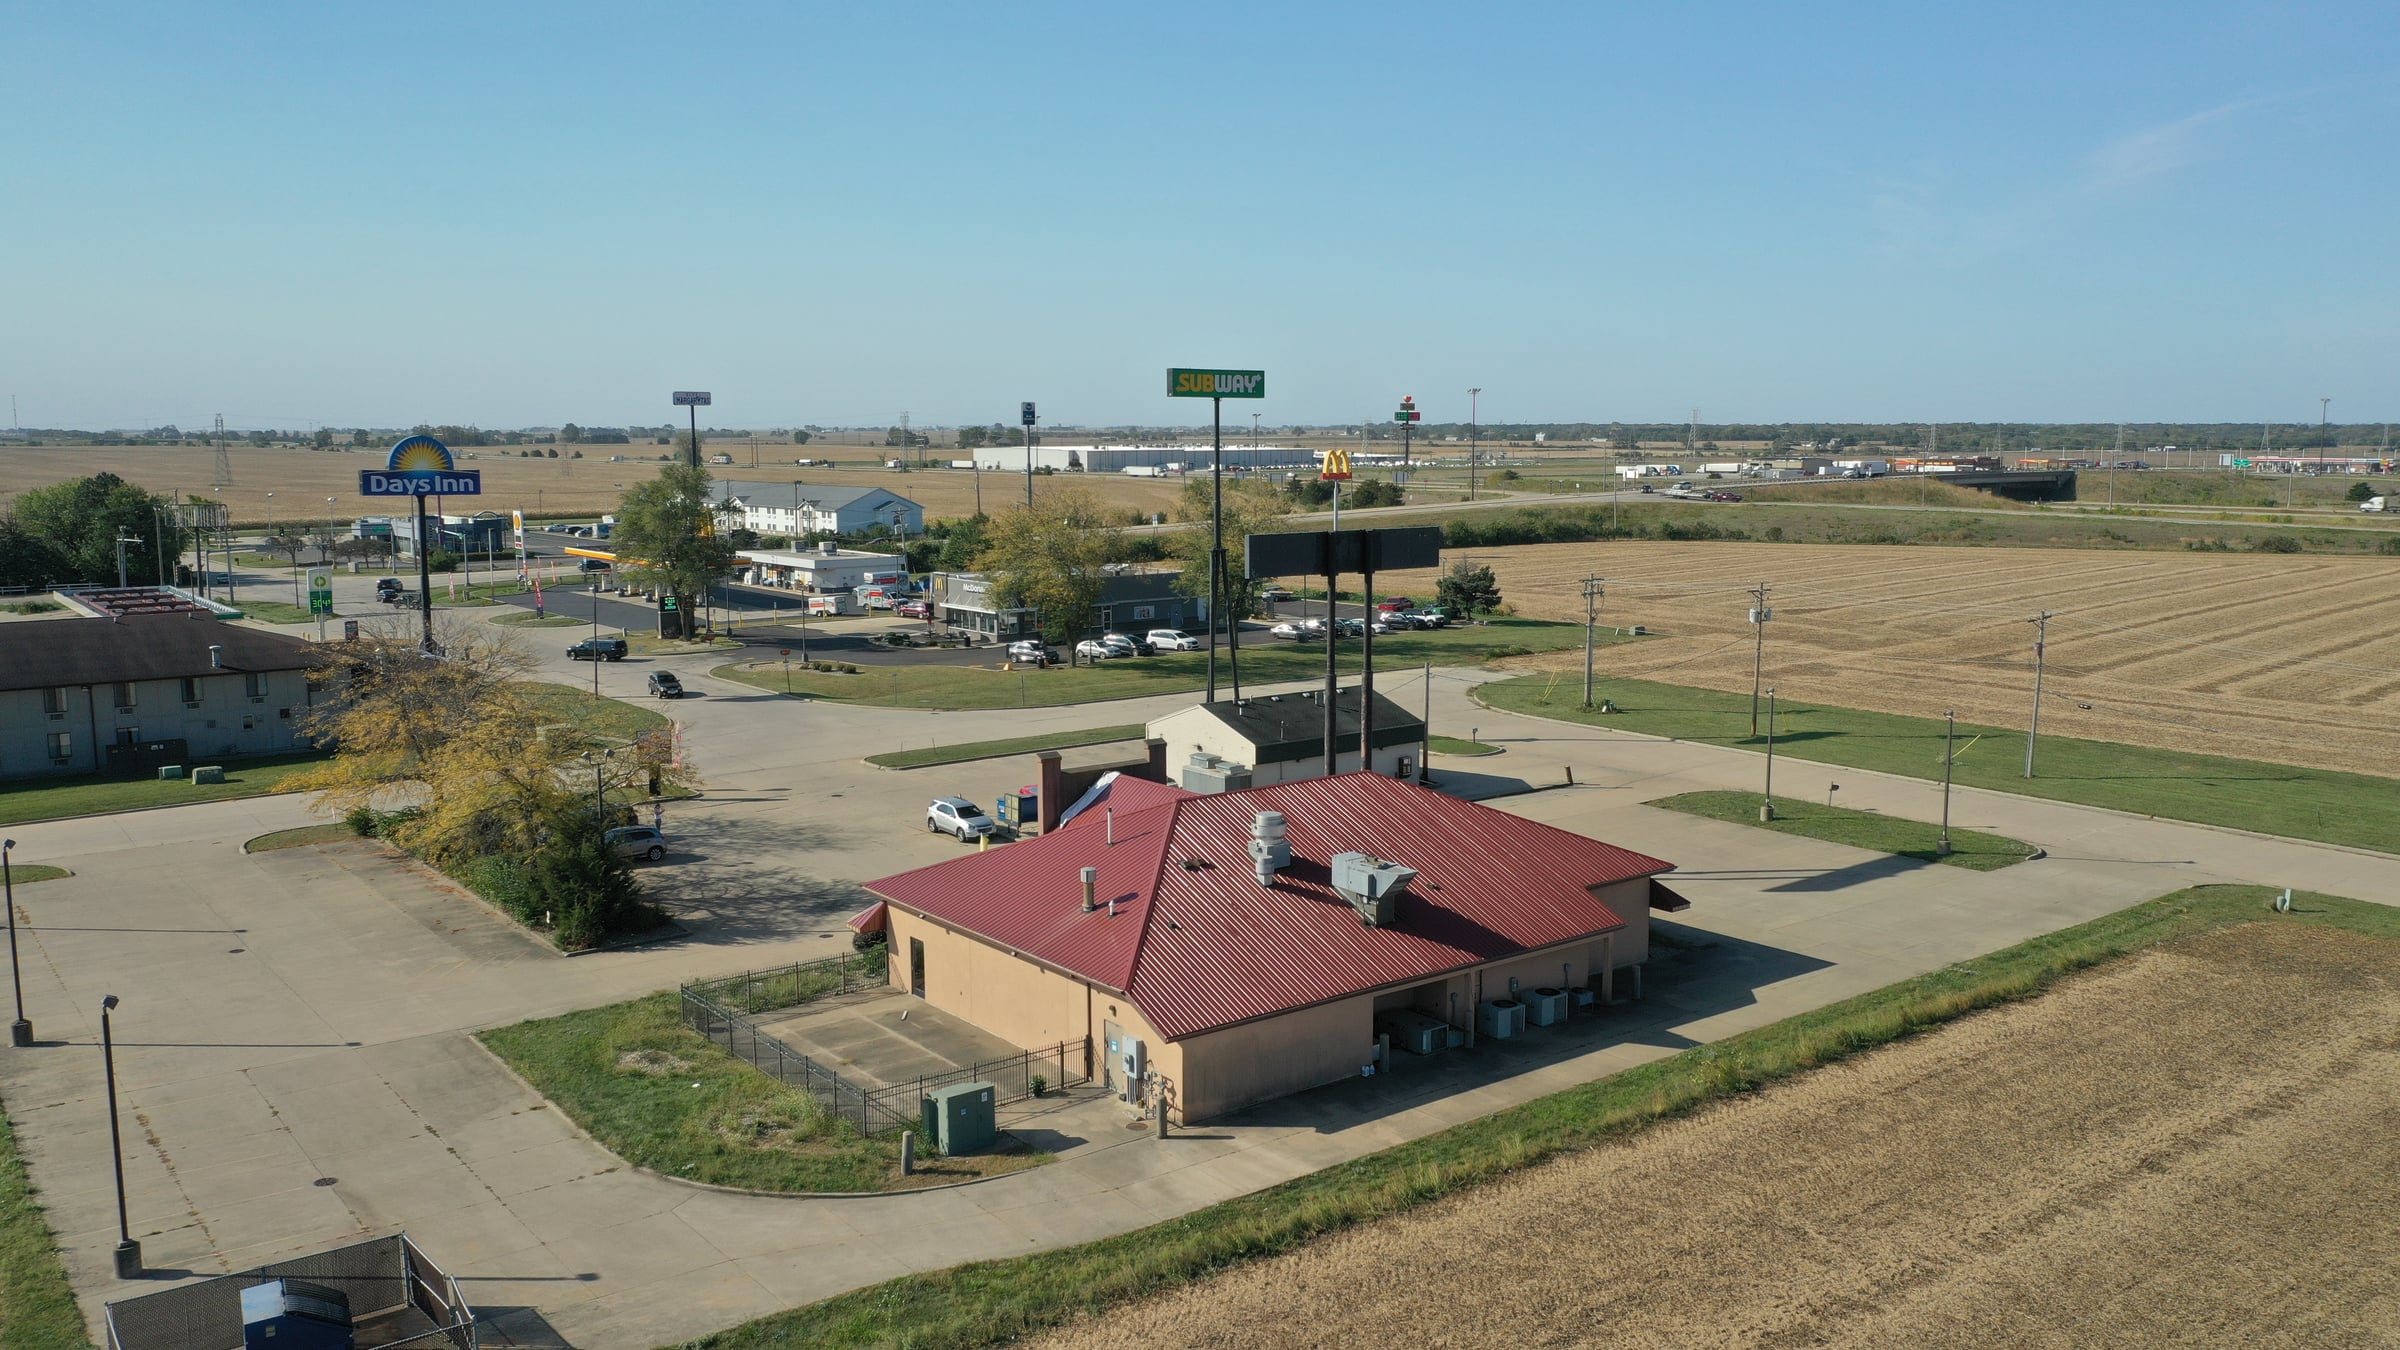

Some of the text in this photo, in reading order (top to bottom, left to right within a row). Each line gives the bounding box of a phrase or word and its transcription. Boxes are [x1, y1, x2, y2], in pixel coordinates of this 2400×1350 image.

[1176, 373, 1262, 393] SUBWAY
[370, 475, 474, 494] Days Inn
